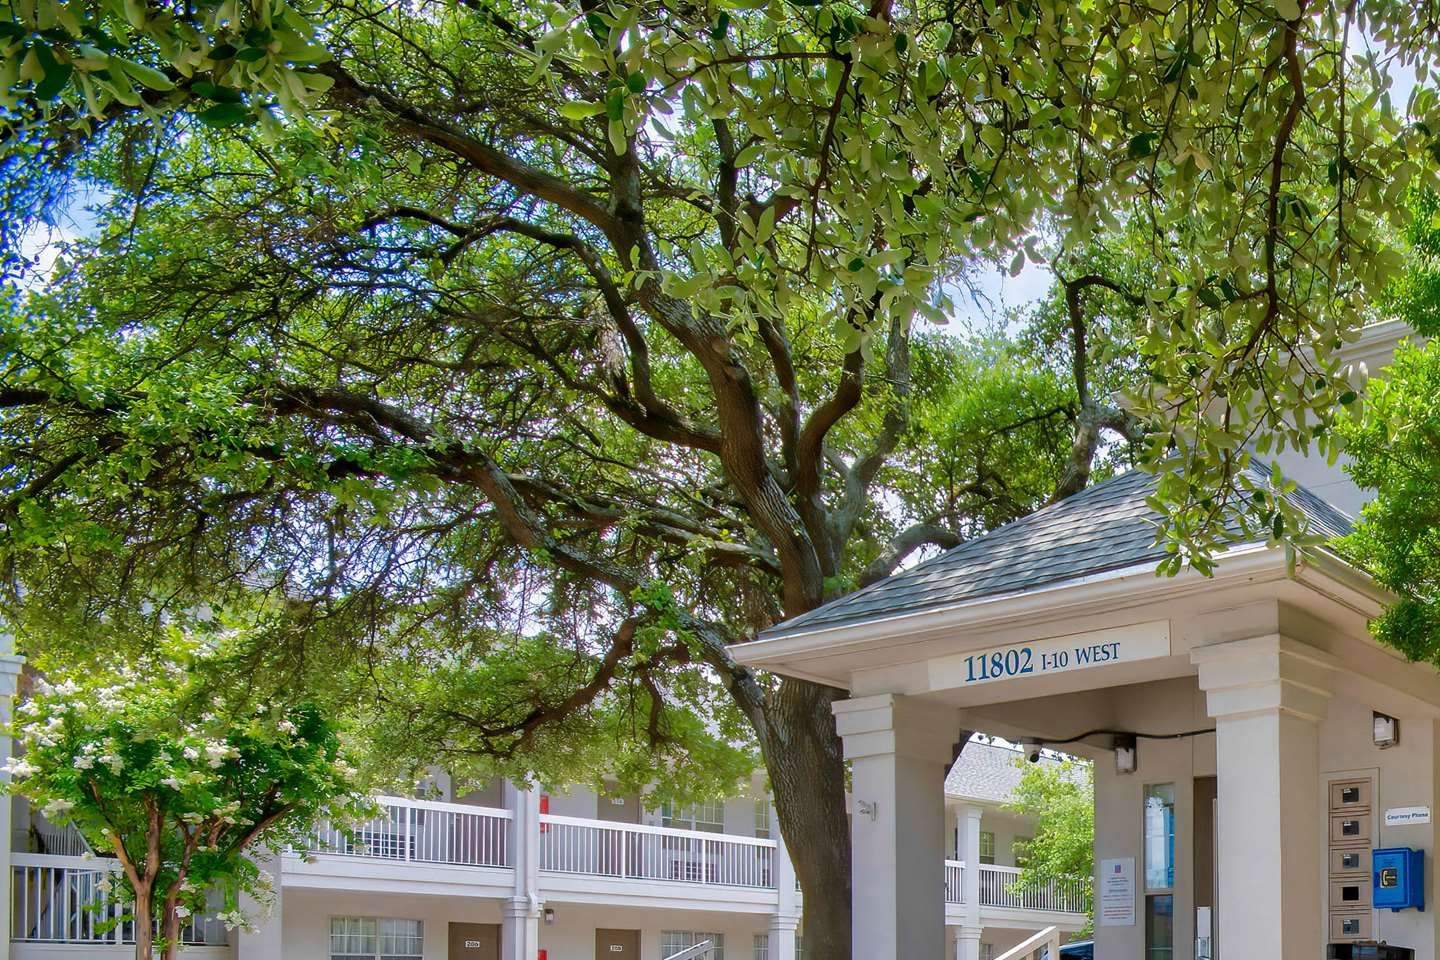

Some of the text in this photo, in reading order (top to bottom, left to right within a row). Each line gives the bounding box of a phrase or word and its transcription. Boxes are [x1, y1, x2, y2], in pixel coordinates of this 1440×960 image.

[964, 642, 1120, 682] 11802 I-10 WEST
